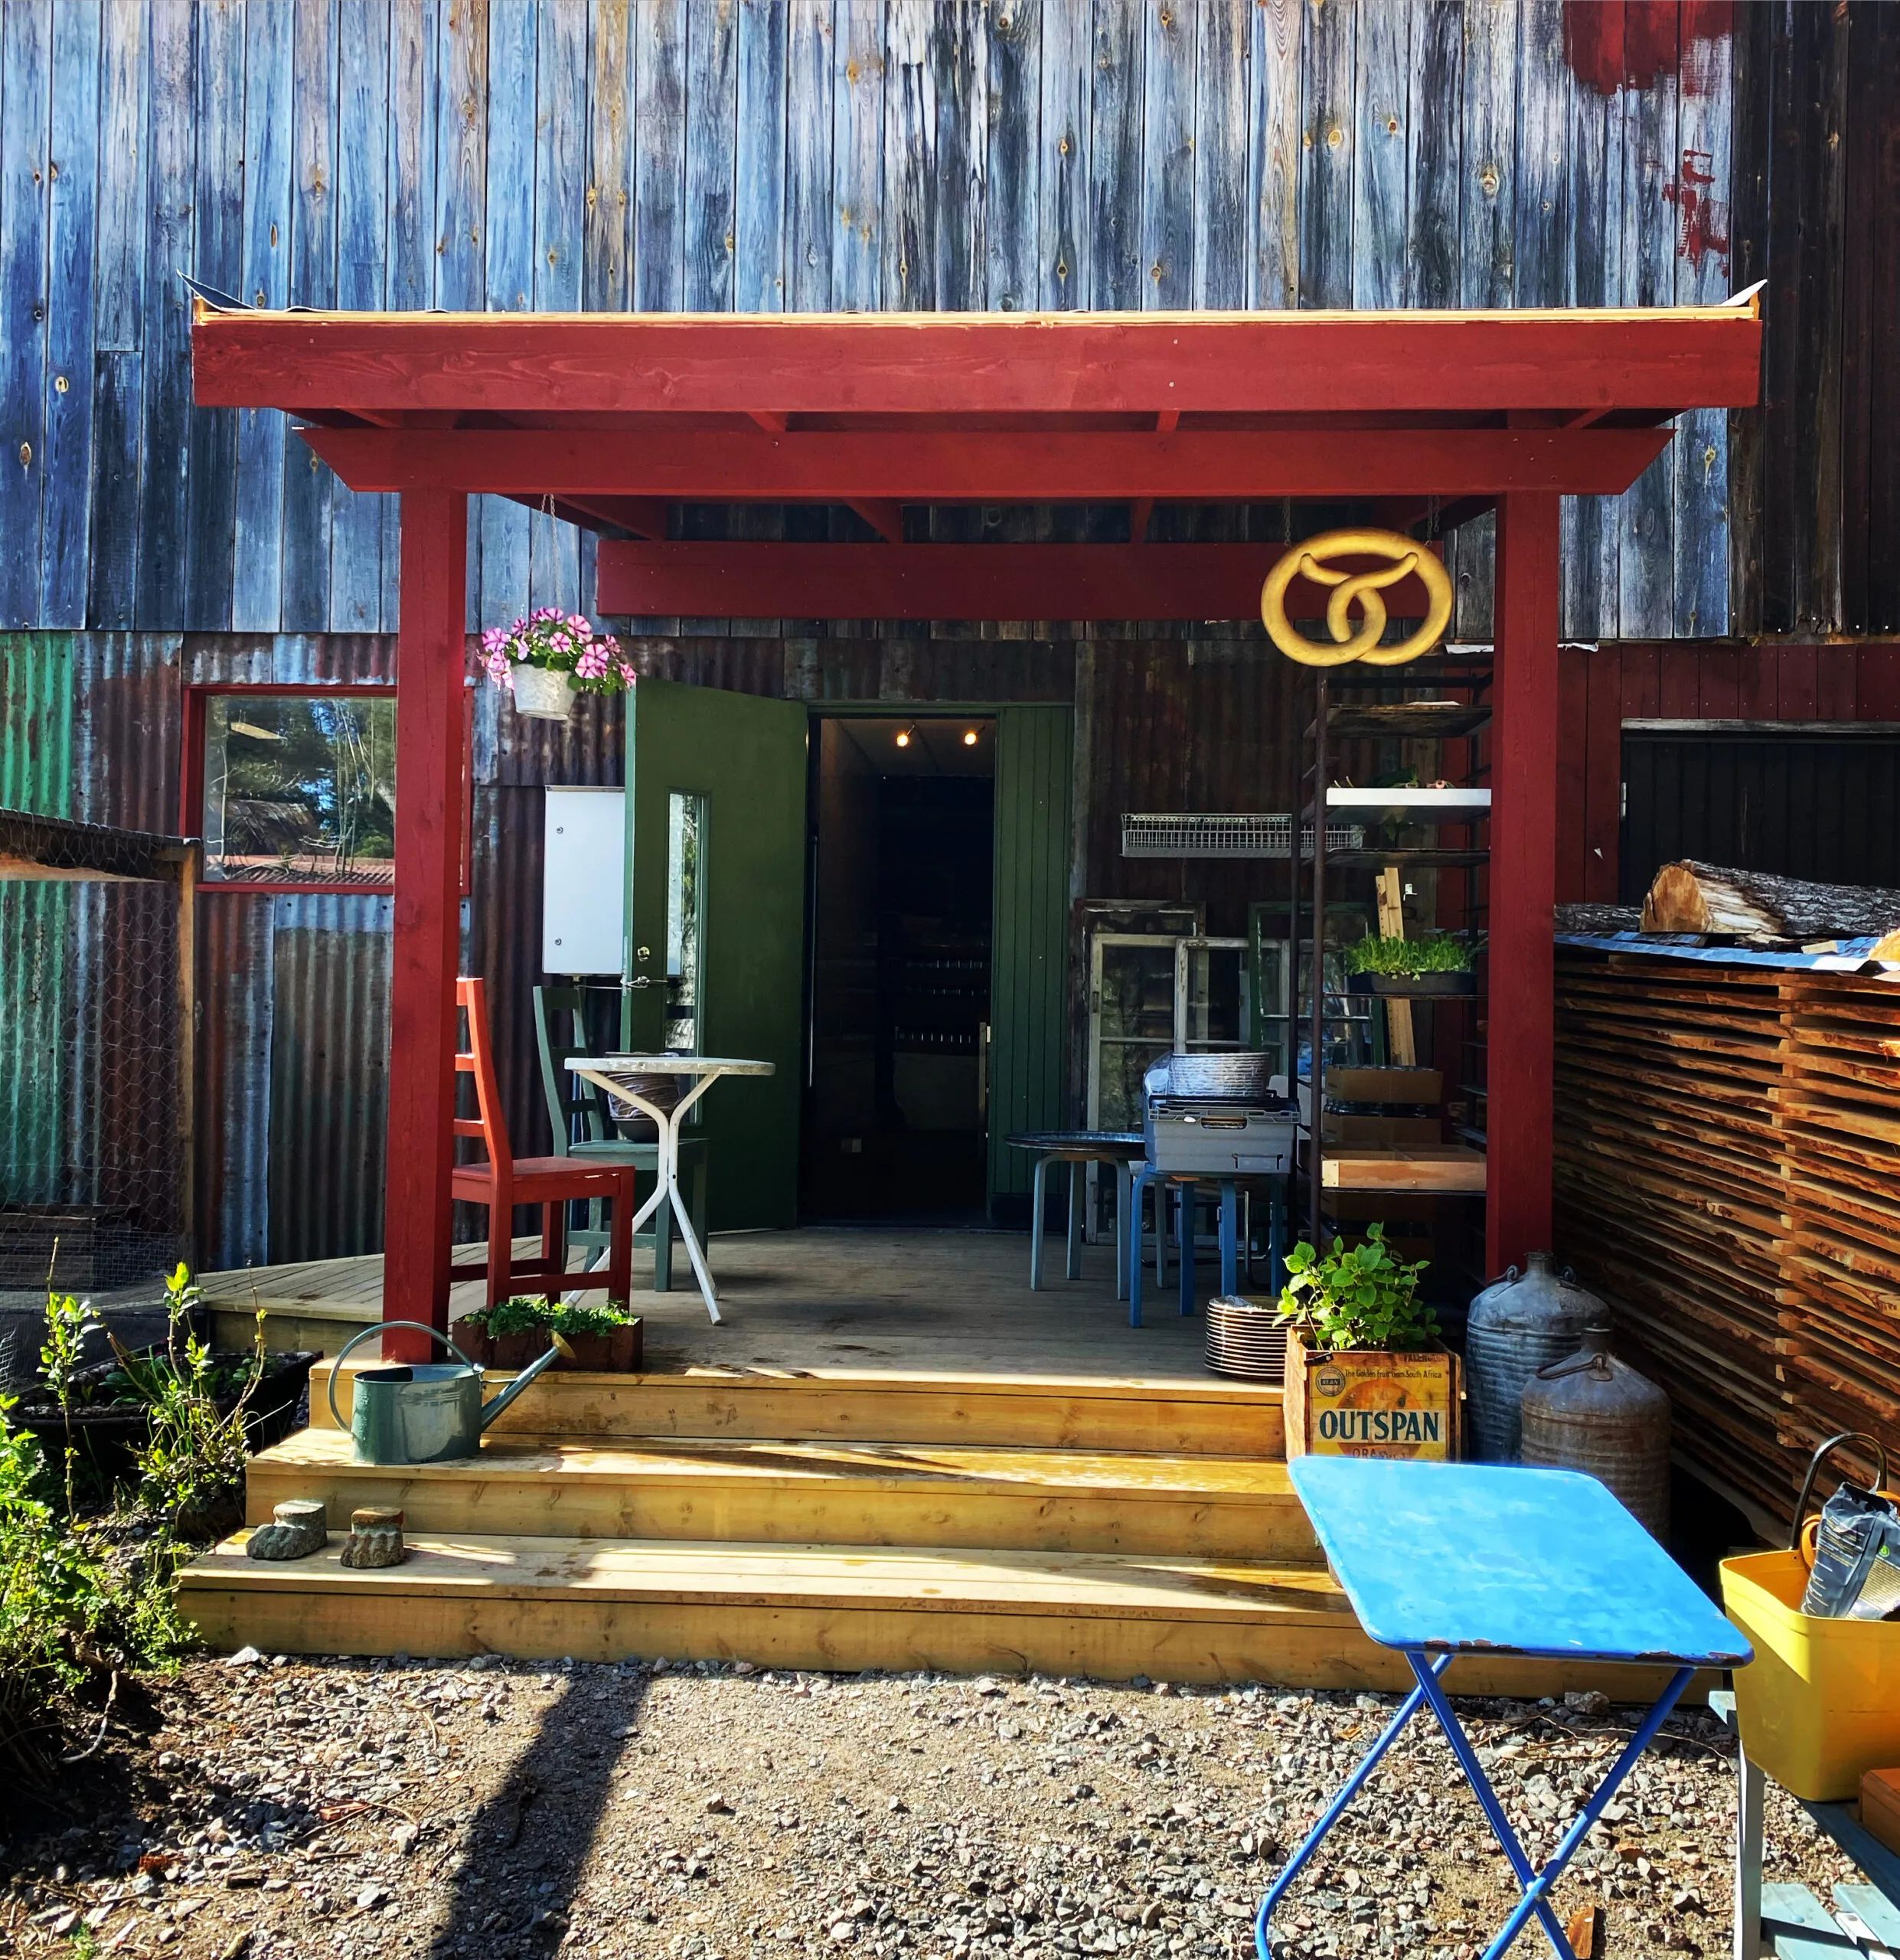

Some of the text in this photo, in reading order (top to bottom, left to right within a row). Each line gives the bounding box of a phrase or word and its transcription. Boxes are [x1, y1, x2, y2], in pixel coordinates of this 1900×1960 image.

[1345, 1368, 1355, 1377] The
[1356, 1368, 1376, 1377] Golden
[1405, 1370, 1422, 1378] South
[1423, 1370, 1441, 1379] Africa
[1319, 1410, 1439, 1442] OUTSPAN
